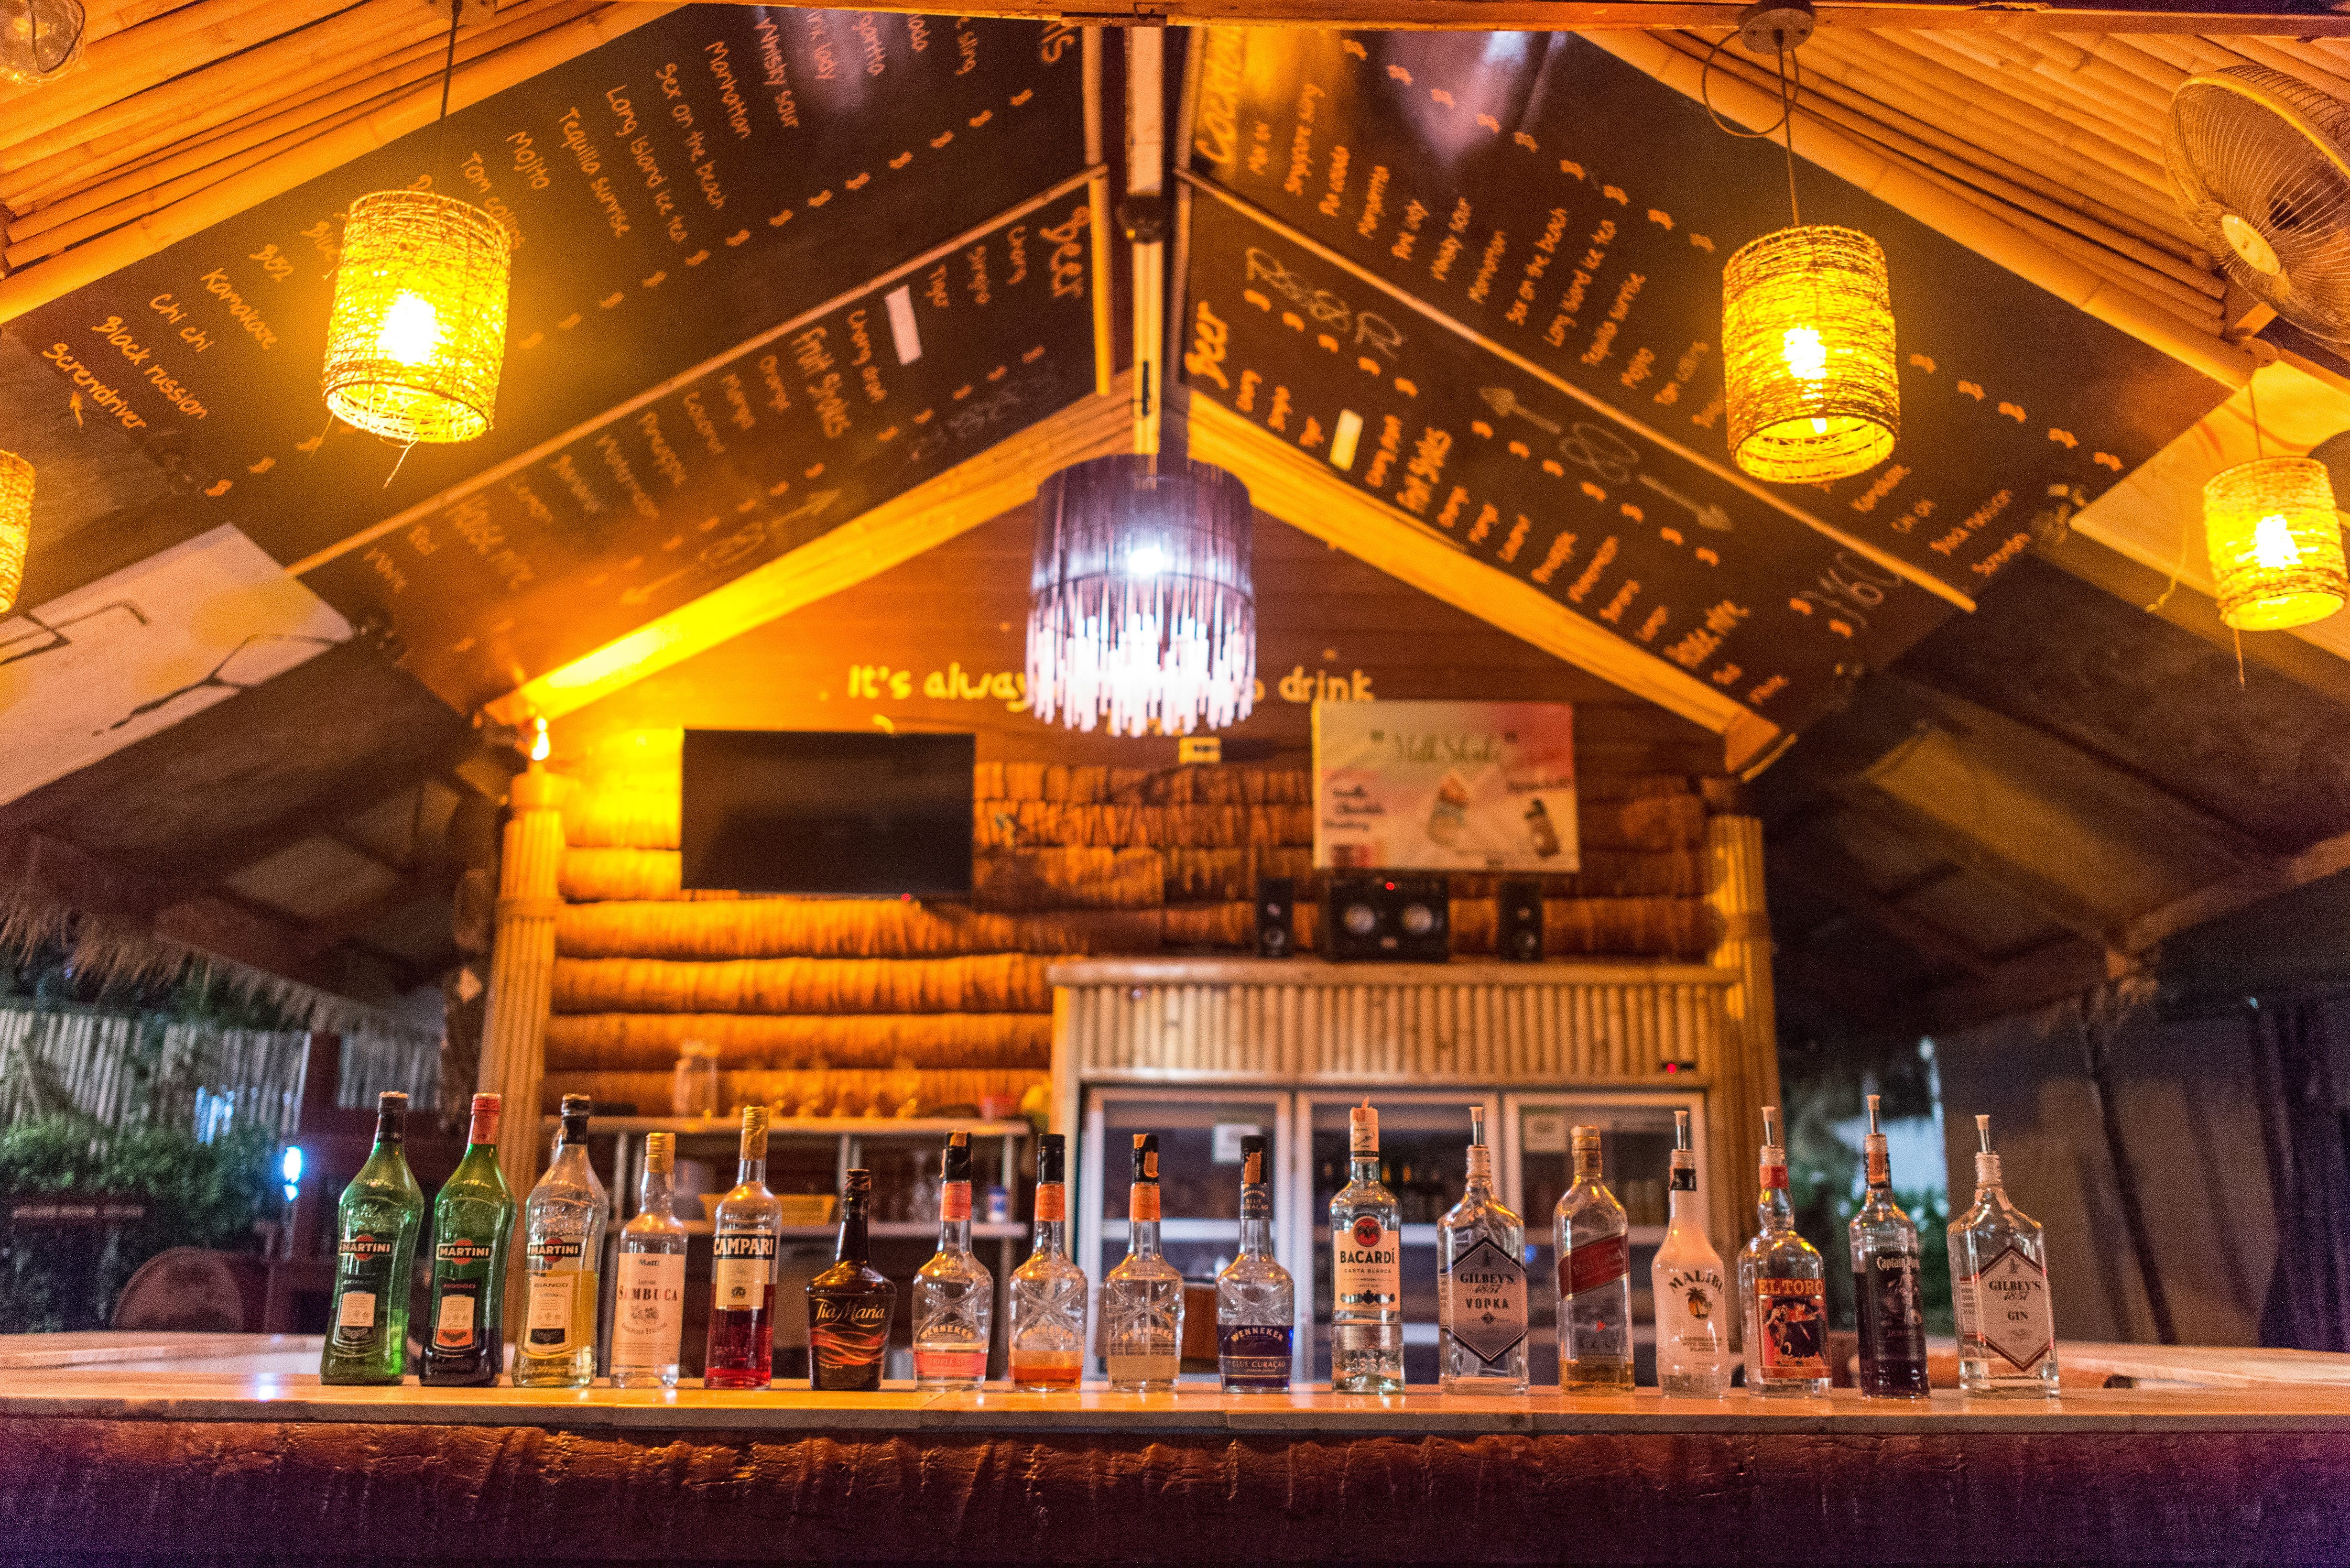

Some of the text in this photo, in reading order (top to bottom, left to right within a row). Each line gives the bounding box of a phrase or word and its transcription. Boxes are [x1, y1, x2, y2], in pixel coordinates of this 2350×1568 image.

[807, 13, 838, 80] ink lady
[705, 41, 752, 139] Manhattan
[755, 18, 799, 129] Whisky sour
[656, 63, 727, 209] Sex on the beach
[461, 152, 491, 192] Tom
[507, 131, 550, 190] Mojito
[559, 108, 630, 238] Tequilla sunrise
[607, 85, 688, 243] Long island ice tea
[1533, 207, 1569, 254] beach
[250, 244, 293, 282] B52
[1006, 225, 1027, 286] Chang
[924, 263, 950, 308] Tiger
[92, 316, 149, 365] Black
[150, 294, 214, 353] Chi chi
[1184, 299, 1230, 391] Beer
[1542, 313, 1578, 348] Long
[720, 373, 756, 429] Mango
[759, 354, 791, 414] Orange
[806, 372, 852, 439] Shakes
[682, 391, 726, 455] Coconut
[636, 411, 686, 488] Pineapple
[1557, 421, 1641, 484] 80
[849, 664, 911, 699] It's
[924, 663, 1028, 712] alway
[1279, 665, 1374, 702] drink
[341, 1241, 391, 1253] MARTINI
[439, 1247, 489, 1257] MARTINI
[530, 1244, 579, 1255] MARTINI
[714, 1237, 773, 1255] CAMPARI
[1340, 1248, 1396, 1264] BACARDÍ
[1876, 1256, 1904, 1271] Captain
[1460, 1272, 1515, 1285] GILBEY'S
[1758, 1279, 1824, 1295] EL TORO
[1989, 1280, 2042, 1291] GILBEY'S
[833, 1299, 885, 1326] Maria
[1466, 1298, 1510, 1309] VODKA
[2008, 1311, 2028, 1321] GIN
[1231, 1326, 1284, 1342] WENNEKER
